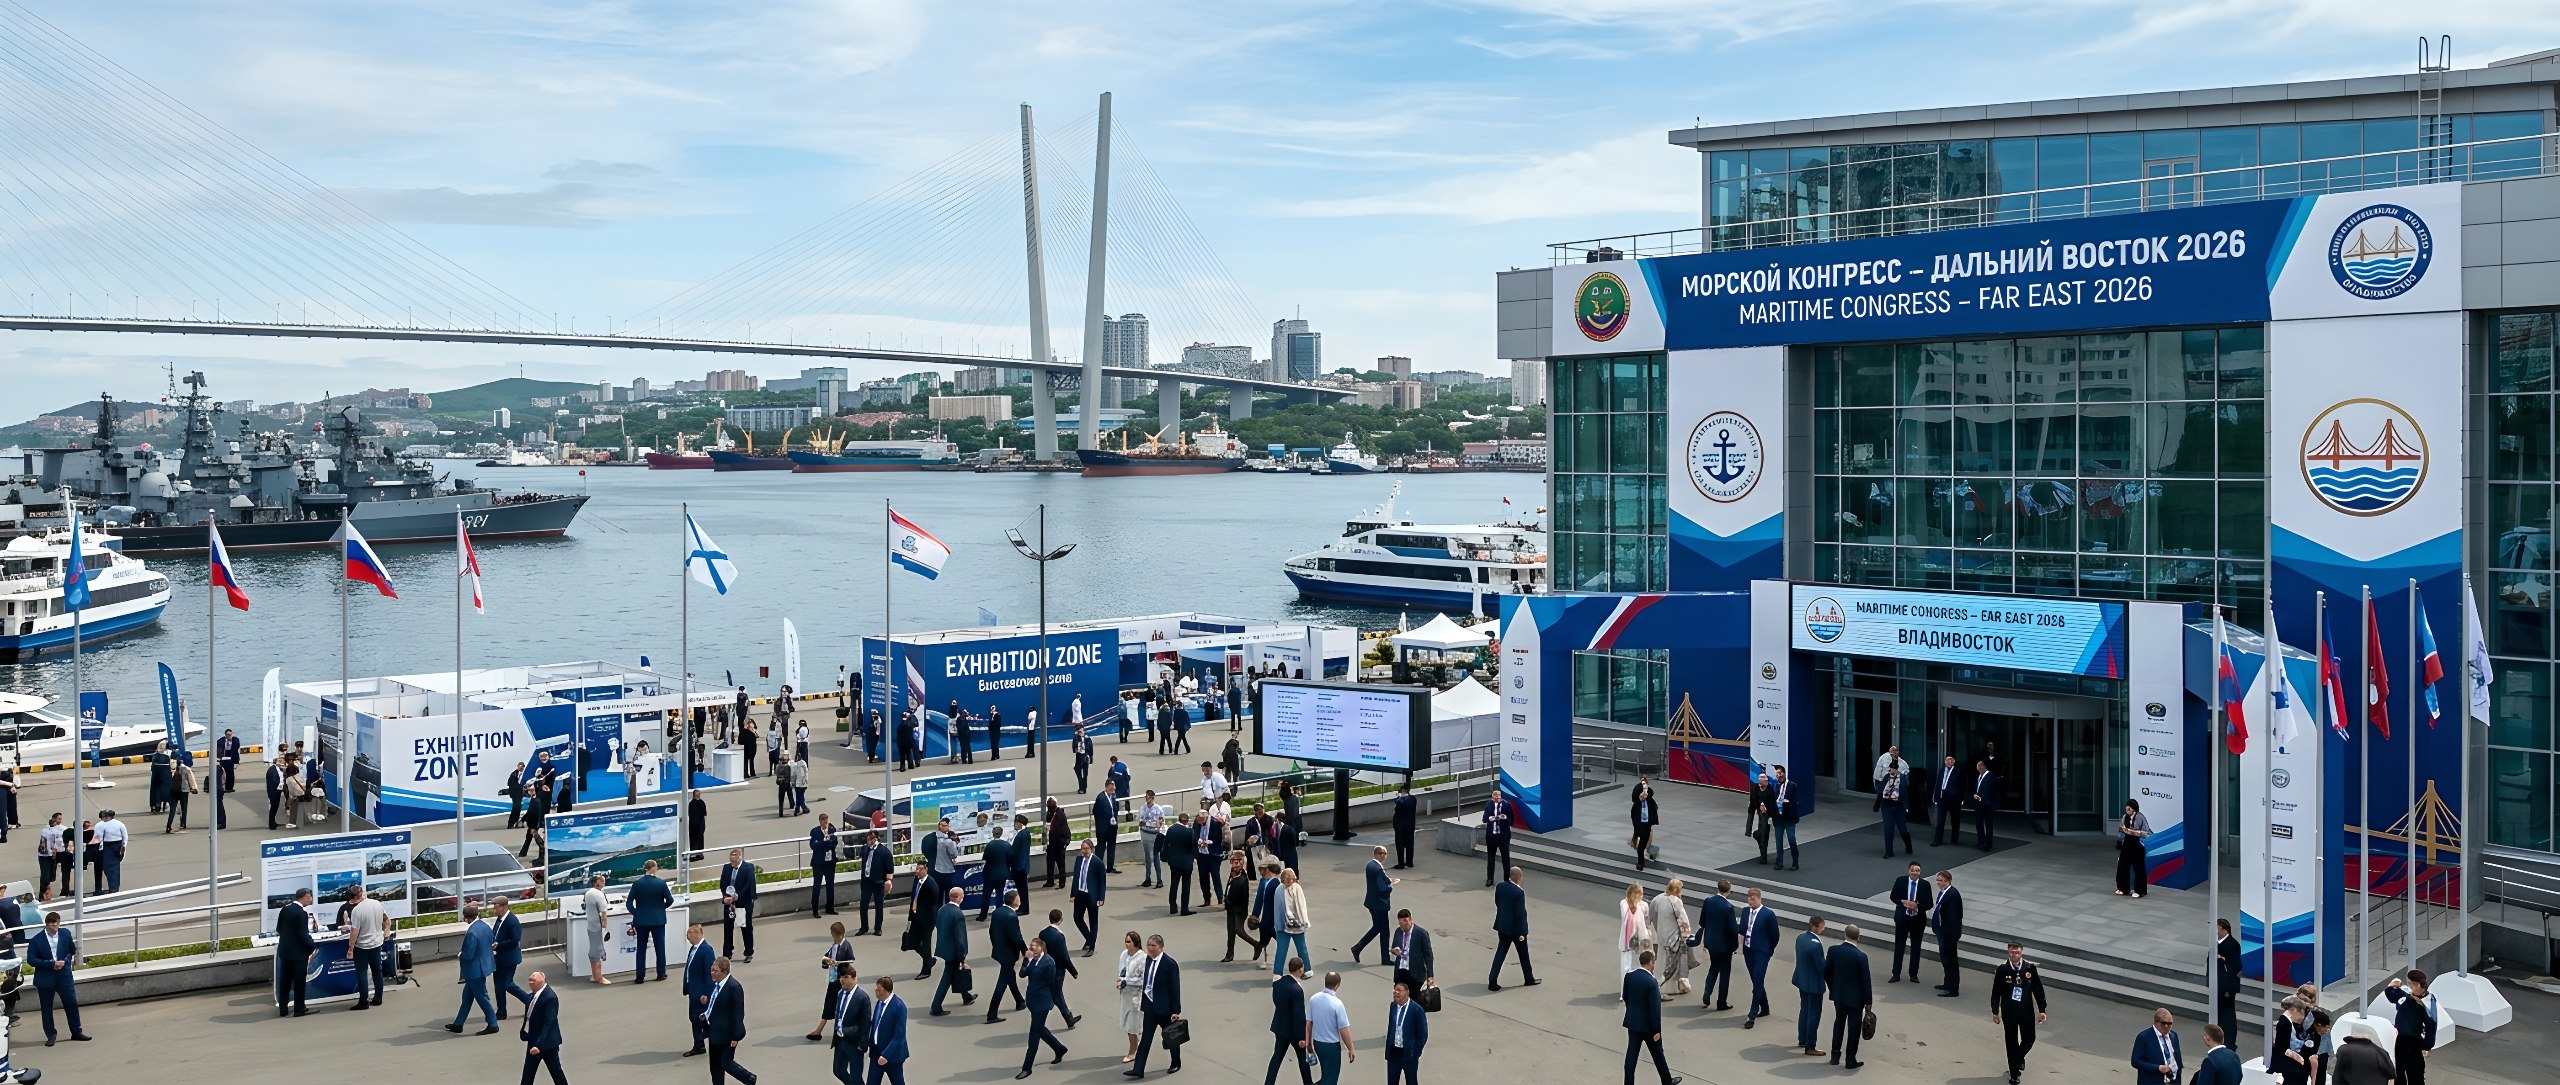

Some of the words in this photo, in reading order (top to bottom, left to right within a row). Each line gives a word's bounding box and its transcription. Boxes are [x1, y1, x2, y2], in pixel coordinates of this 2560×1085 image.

[1682, 263, 1781, 298] МОРСКОЙ
[1788, 258, 1902, 291] КОНГРЕСС
[1931, 239, 2053, 284] ДАЛЬНИЙ
[2062, 236, 2170, 270] ВОСТОК
[2177, 229, 2246, 262] 2026
[1739, 298, 1834, 325] MARITIME
[1840, 290, 1951, 319] CONGRESS
[1979, 285, 2020, 310] FAR
[2028, 280, 2086, 308] EAST
[2094, 276, 2152, 303] 2026
[1056, 643, 1102, 667] ZONE
[1898, 629, 2015, 653] ВЛАДИВОСТОК
[414, 753, 479, 782] ZONE
